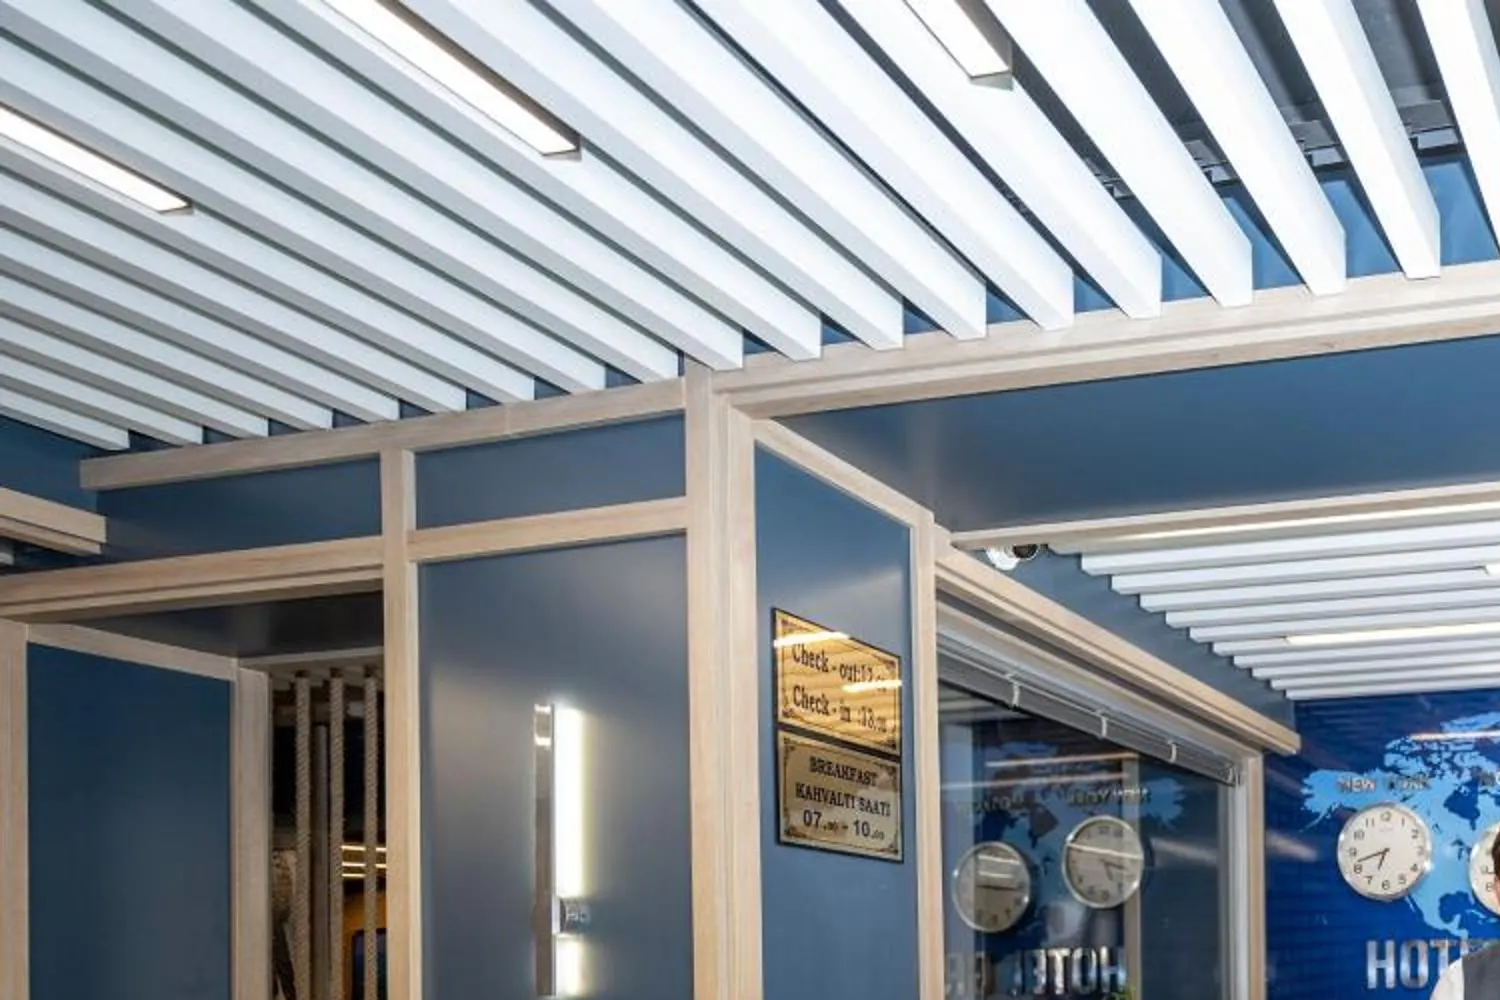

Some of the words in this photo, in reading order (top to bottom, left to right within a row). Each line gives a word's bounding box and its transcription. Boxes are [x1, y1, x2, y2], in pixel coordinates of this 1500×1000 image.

[792, 643, 829, 672] Check
[793, 684, 830, 716] Check
[809, 755, 878, 787] BREAKFAST
